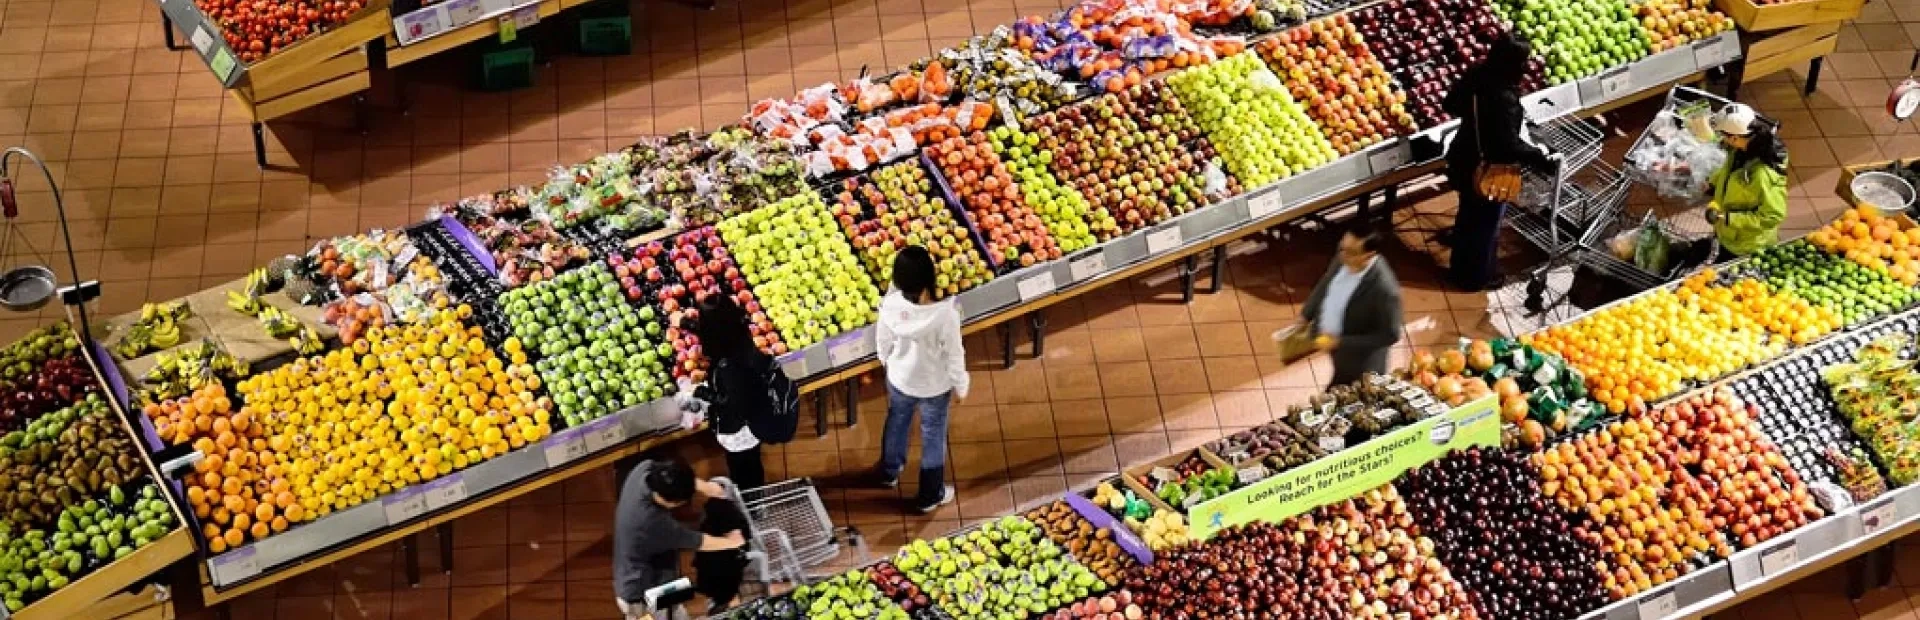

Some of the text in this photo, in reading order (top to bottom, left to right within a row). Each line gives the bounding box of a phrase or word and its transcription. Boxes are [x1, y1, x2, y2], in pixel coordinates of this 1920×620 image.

[1247, 481, 1292, 504] Looking
[1296, 474, 1311, 487] for
[1315, 451, 1371, 479] nutritious
[1374, 430, 1423, 457] choices?
[1279, 484, 1315, 504] Reach
[1317, 477, 1334, 490] for
[1337, 470, 1356, 483] the
